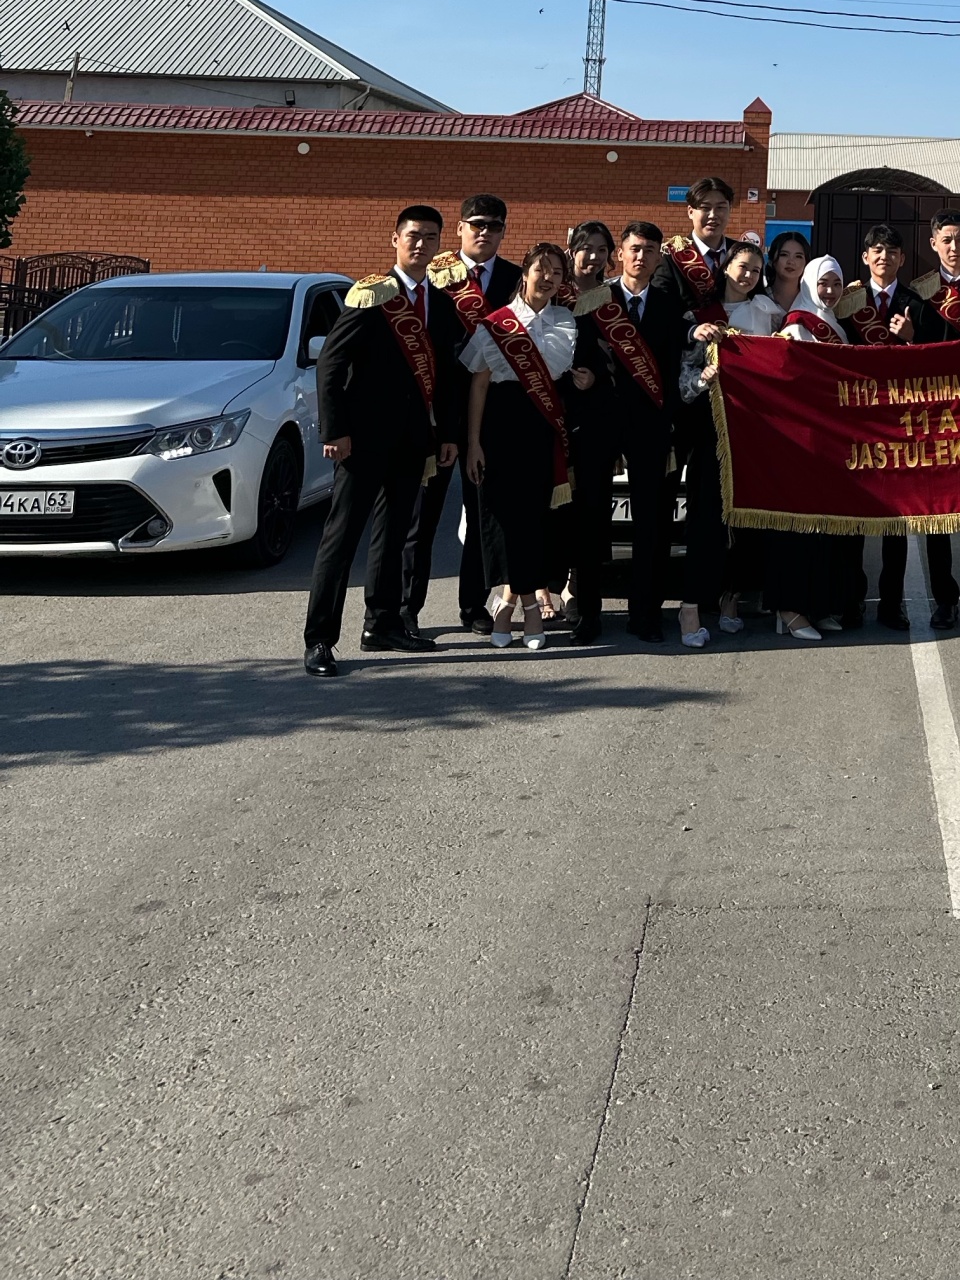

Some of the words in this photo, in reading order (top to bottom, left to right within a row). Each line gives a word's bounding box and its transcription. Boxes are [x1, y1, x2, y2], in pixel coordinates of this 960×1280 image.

[900, 410, 930, 437] 11
[938, 408, 959, 434] A
[0, 493, 42, 513] 4KA
[47, 492, 68, 507] 63
